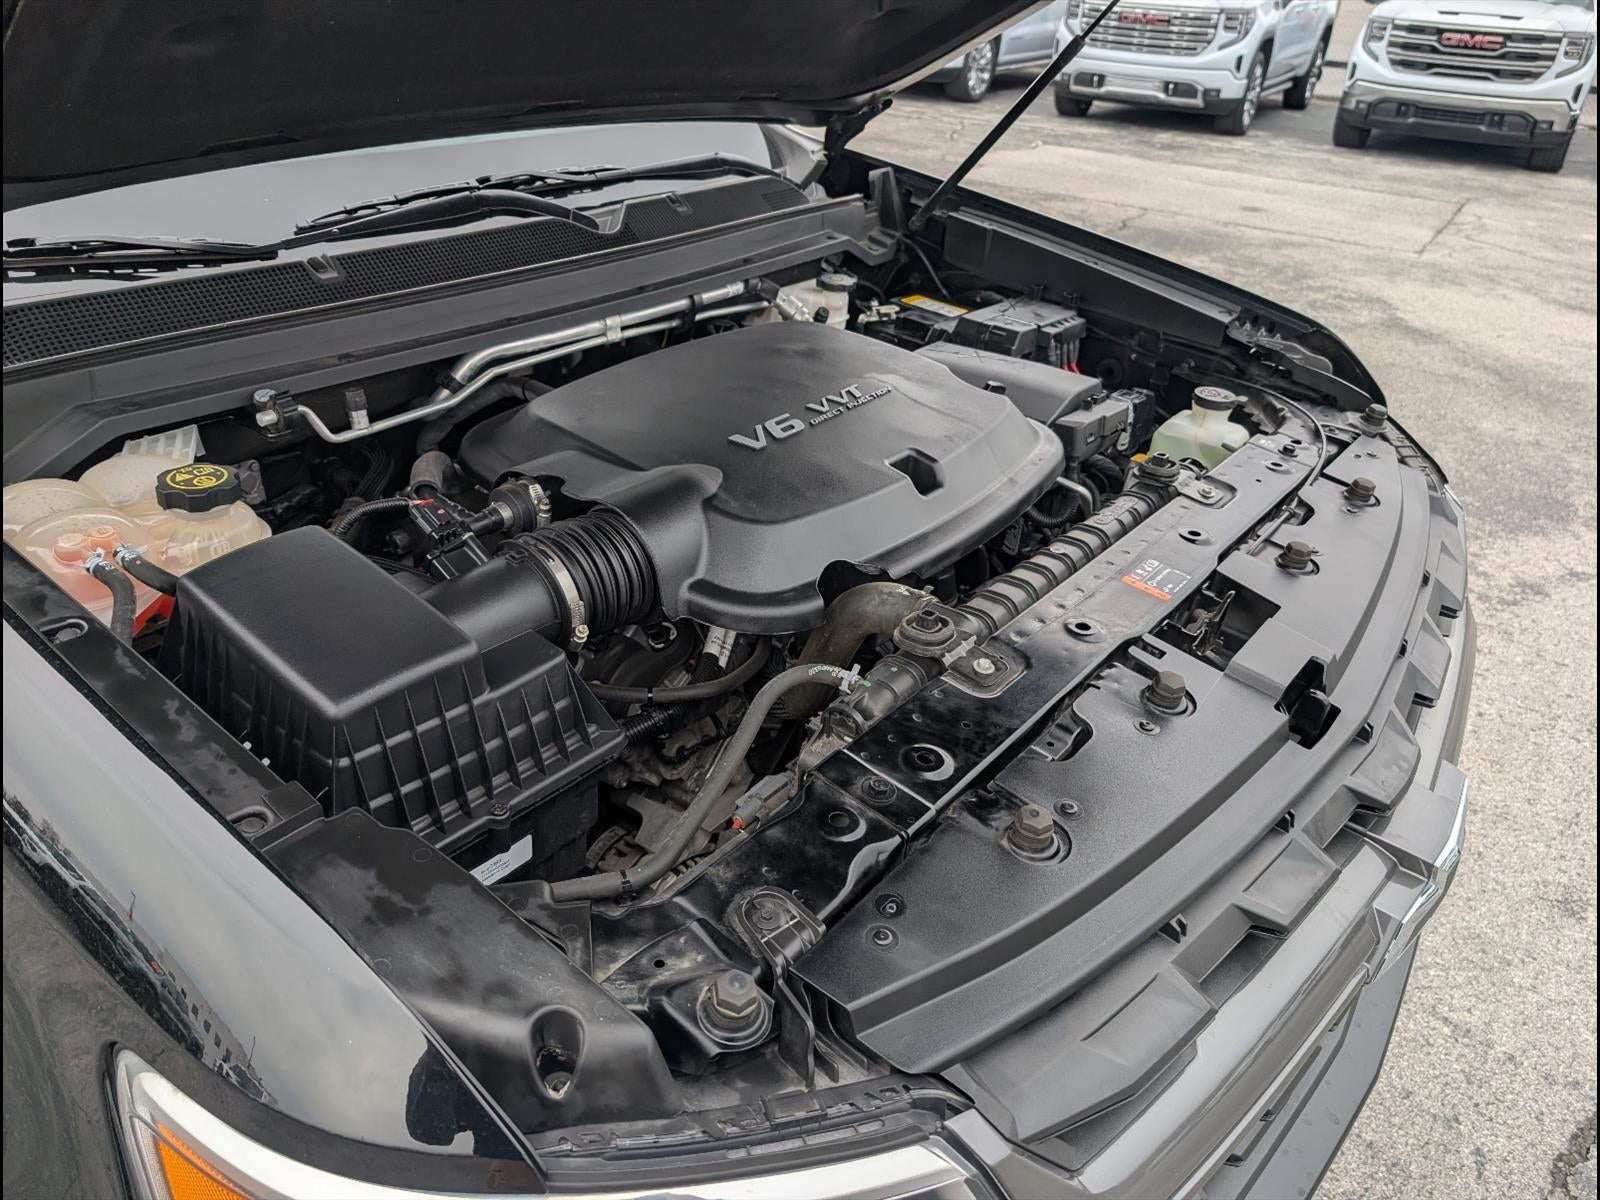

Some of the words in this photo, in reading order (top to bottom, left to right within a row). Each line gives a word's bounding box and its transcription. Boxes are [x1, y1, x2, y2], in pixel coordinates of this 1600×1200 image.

[1119, 11, 1170, 27] GMC
[1440, 31, 1504, 50] GMC
[728, 413, 805, 450] V6
[805, 384, 864, 413] VVT
[810, 406, 845, 426] DIRECT
[847, 385, 893, 410] INJECTION
